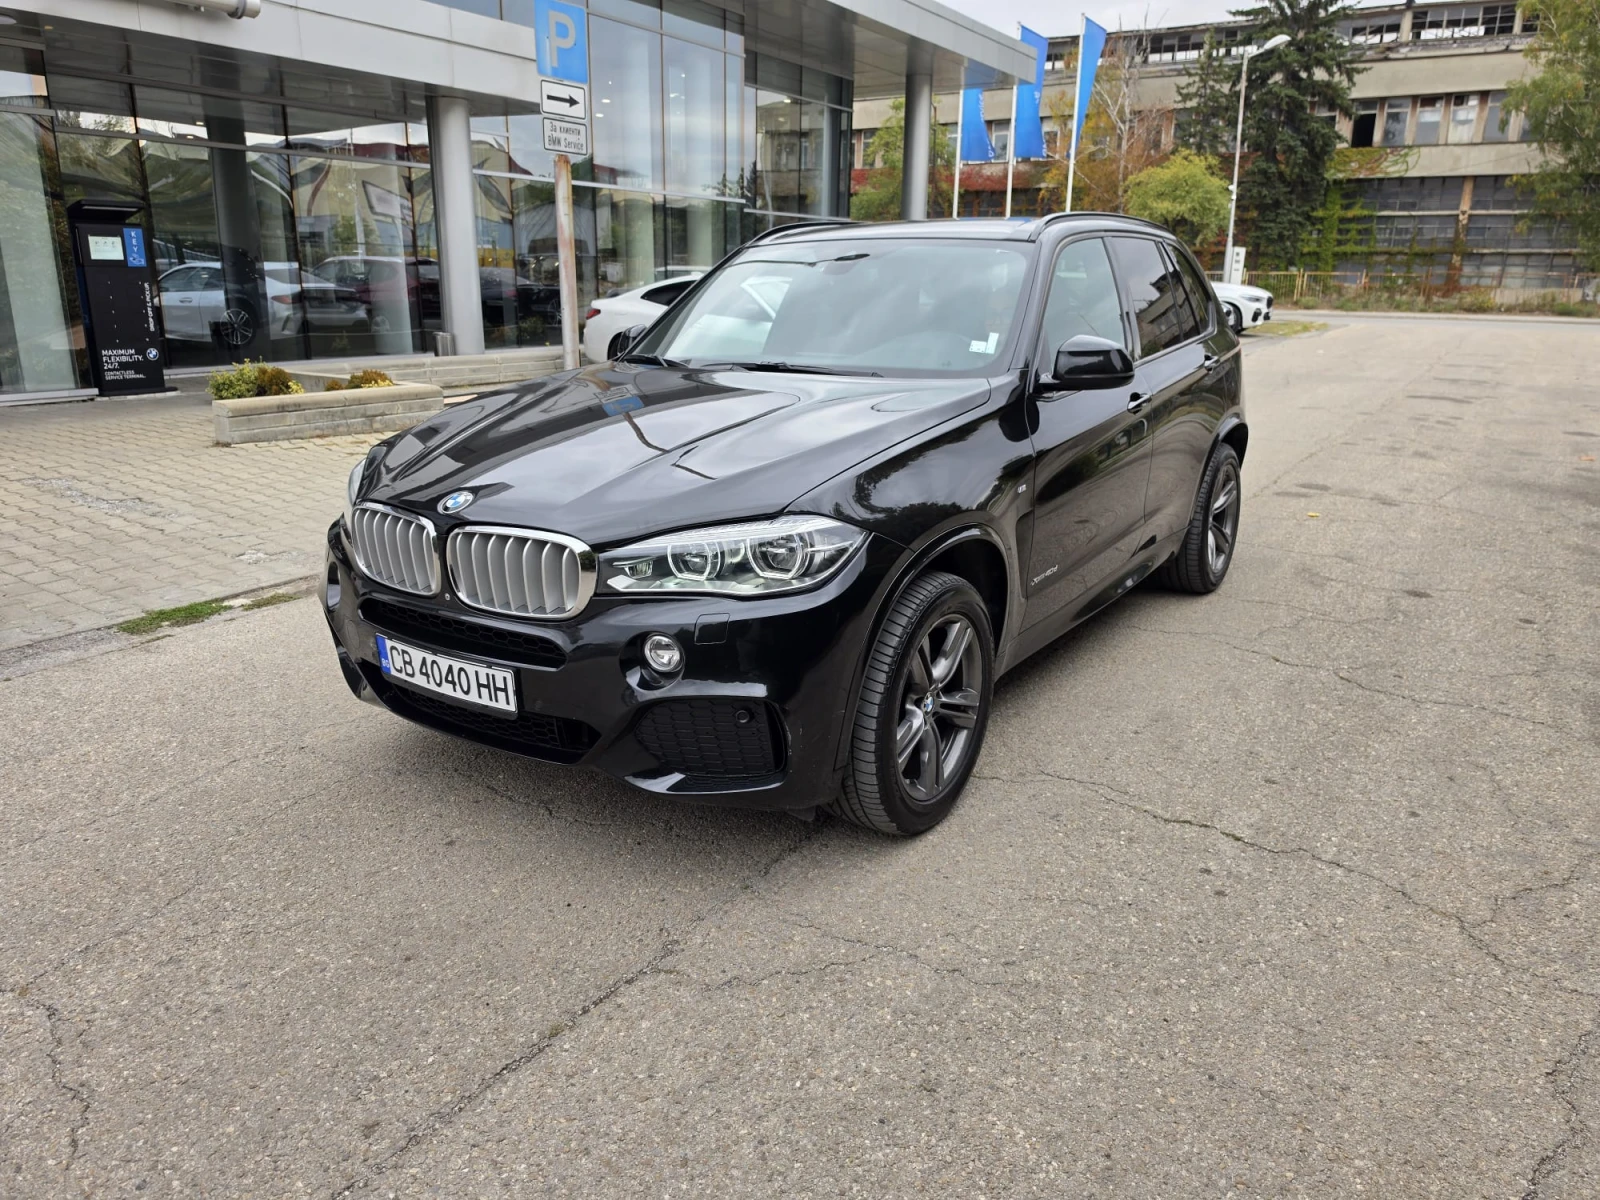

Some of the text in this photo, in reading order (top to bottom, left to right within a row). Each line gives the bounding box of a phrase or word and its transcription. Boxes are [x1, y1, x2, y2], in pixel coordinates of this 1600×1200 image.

[549, 10, 576, 67] P
[549, 122, 580, 138] За клиенти
[547, 135, 584, 151] BMW Service
[103, 354, 144, 362] FLEXIBILITY.
[390, 646, 510, 705] CB 4040 HH
